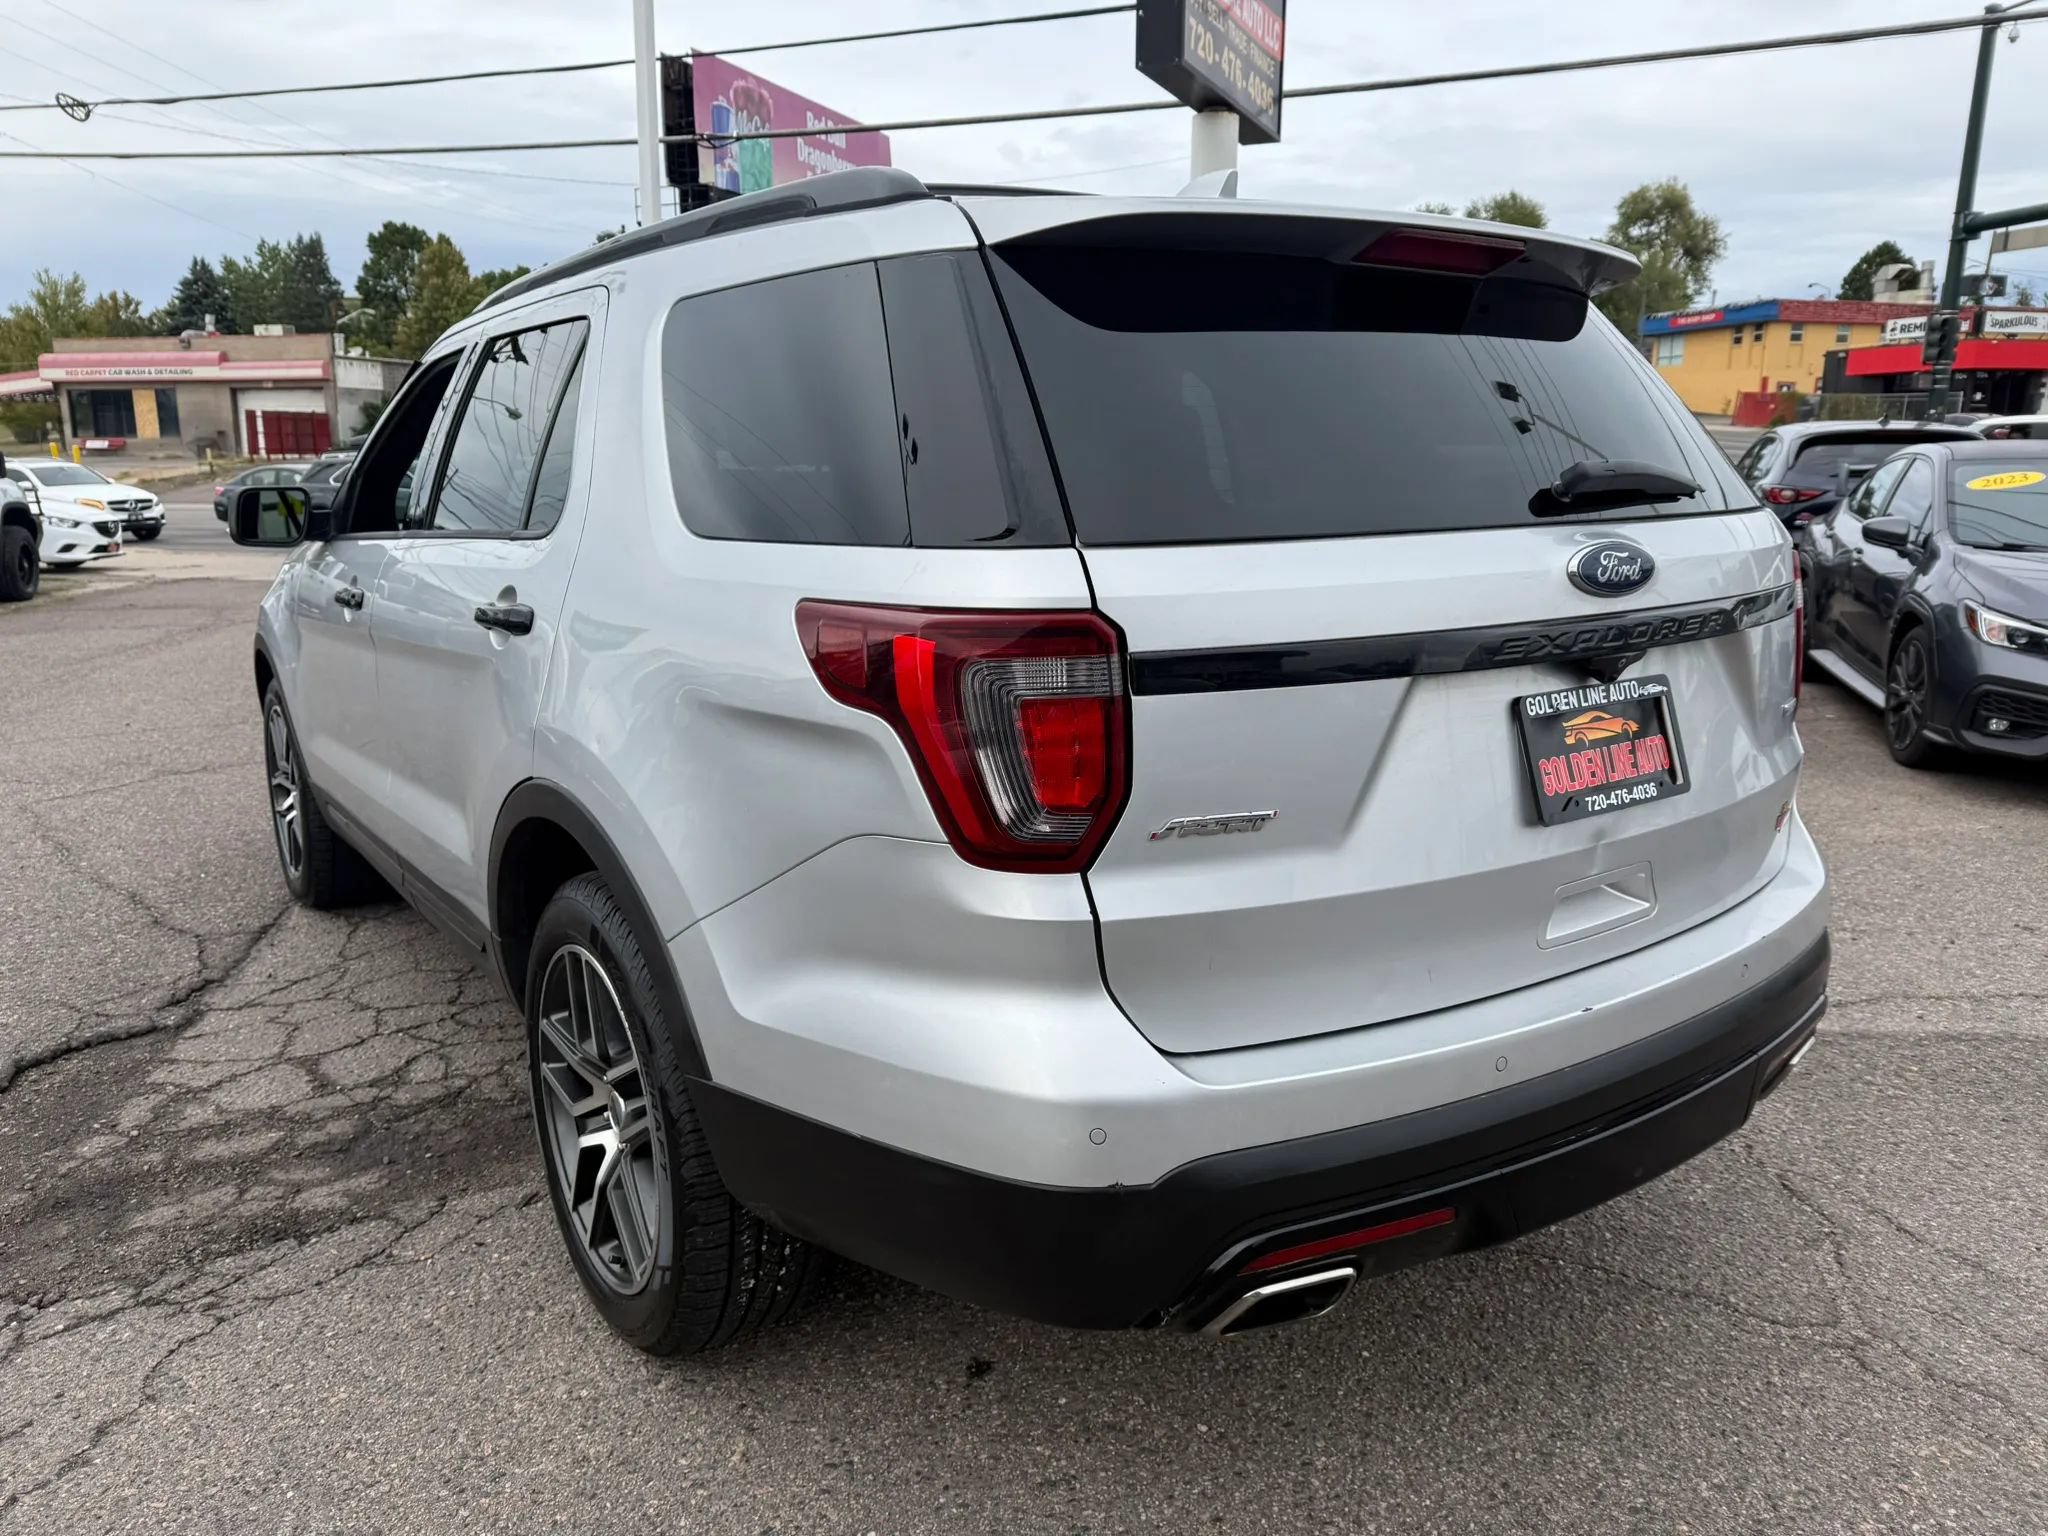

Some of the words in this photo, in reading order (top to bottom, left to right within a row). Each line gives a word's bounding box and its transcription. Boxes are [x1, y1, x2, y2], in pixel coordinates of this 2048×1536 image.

[1241, 0, 1264, 39] AUTO
[1264, 13, 1281, 51] LLC
[1990, 315, 2038, 329] SPARKULOUS
[108, 368, 122, 376] CAR
[154, 367, 193, 375] DETAILING
[1982, 473, 2029, 488] 2023
[1598, 551, 1642, 582] Ford
[1493, 610, 1724, 661] EXPLORER
[1526, 692, 1579, 716] GOLDEN
[1579, 687, 1608, 707] LINE
[1609, 681, 1640, 701] AUTO
[1538, 747, 1608, 797] GOLDEN
[1604, 741, 1638, 783] LINE
[1635, 734, 1670, 776] AUTO
[1585, 782, 1658, 812] 720-476-4036
